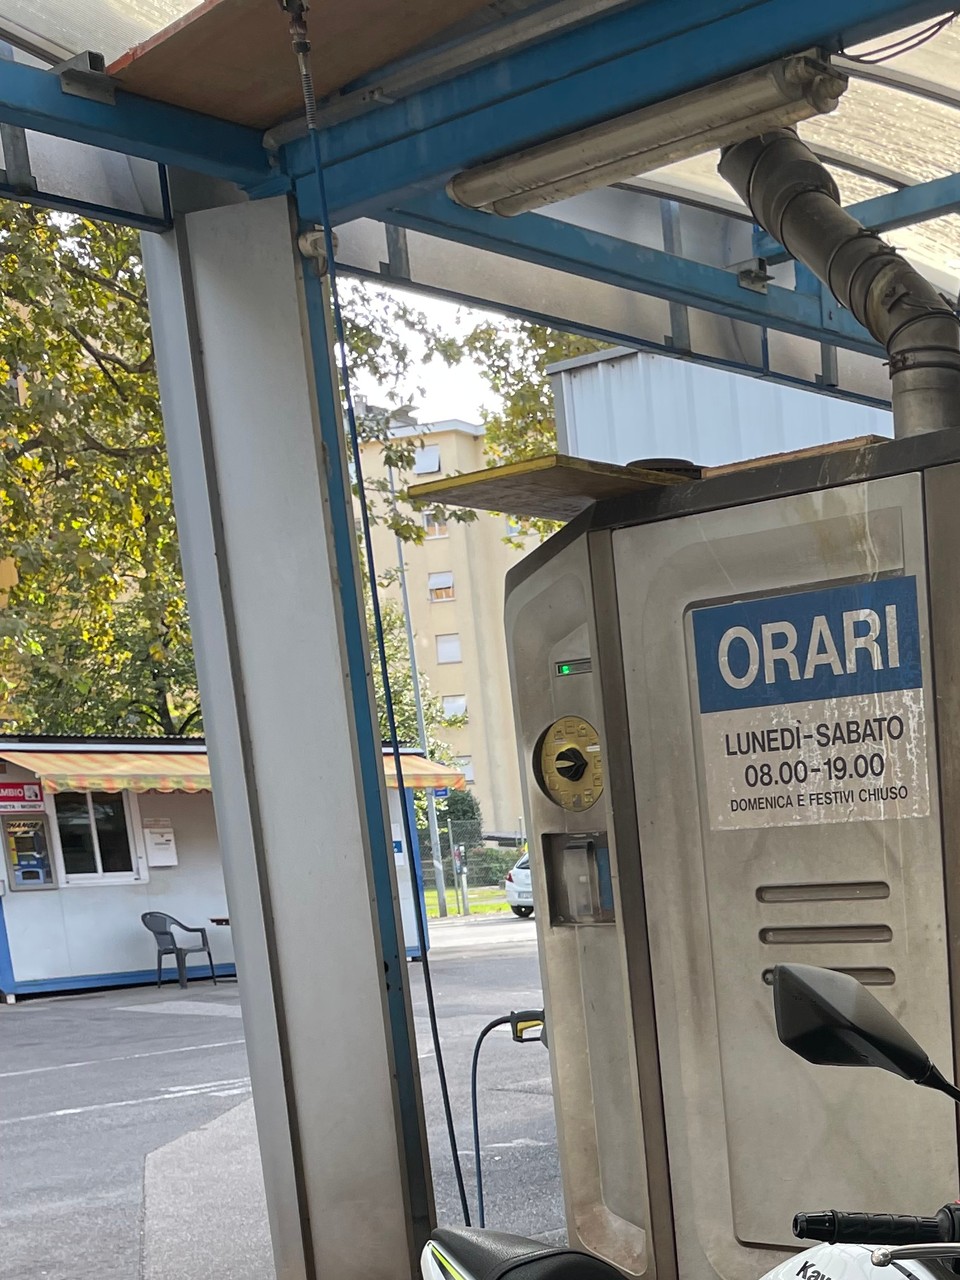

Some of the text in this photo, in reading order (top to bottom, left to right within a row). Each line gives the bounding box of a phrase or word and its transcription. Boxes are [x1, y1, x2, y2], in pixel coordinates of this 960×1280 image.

[718, 604, 900, 689] ORARI
[725, 715, 904, 756] LUNEDÌ-SABATO
[744, 753, 885, 787] 08.00-19.00
[730, 785, 908, 812] DOMENICA E FESTIVI CHIUSO
